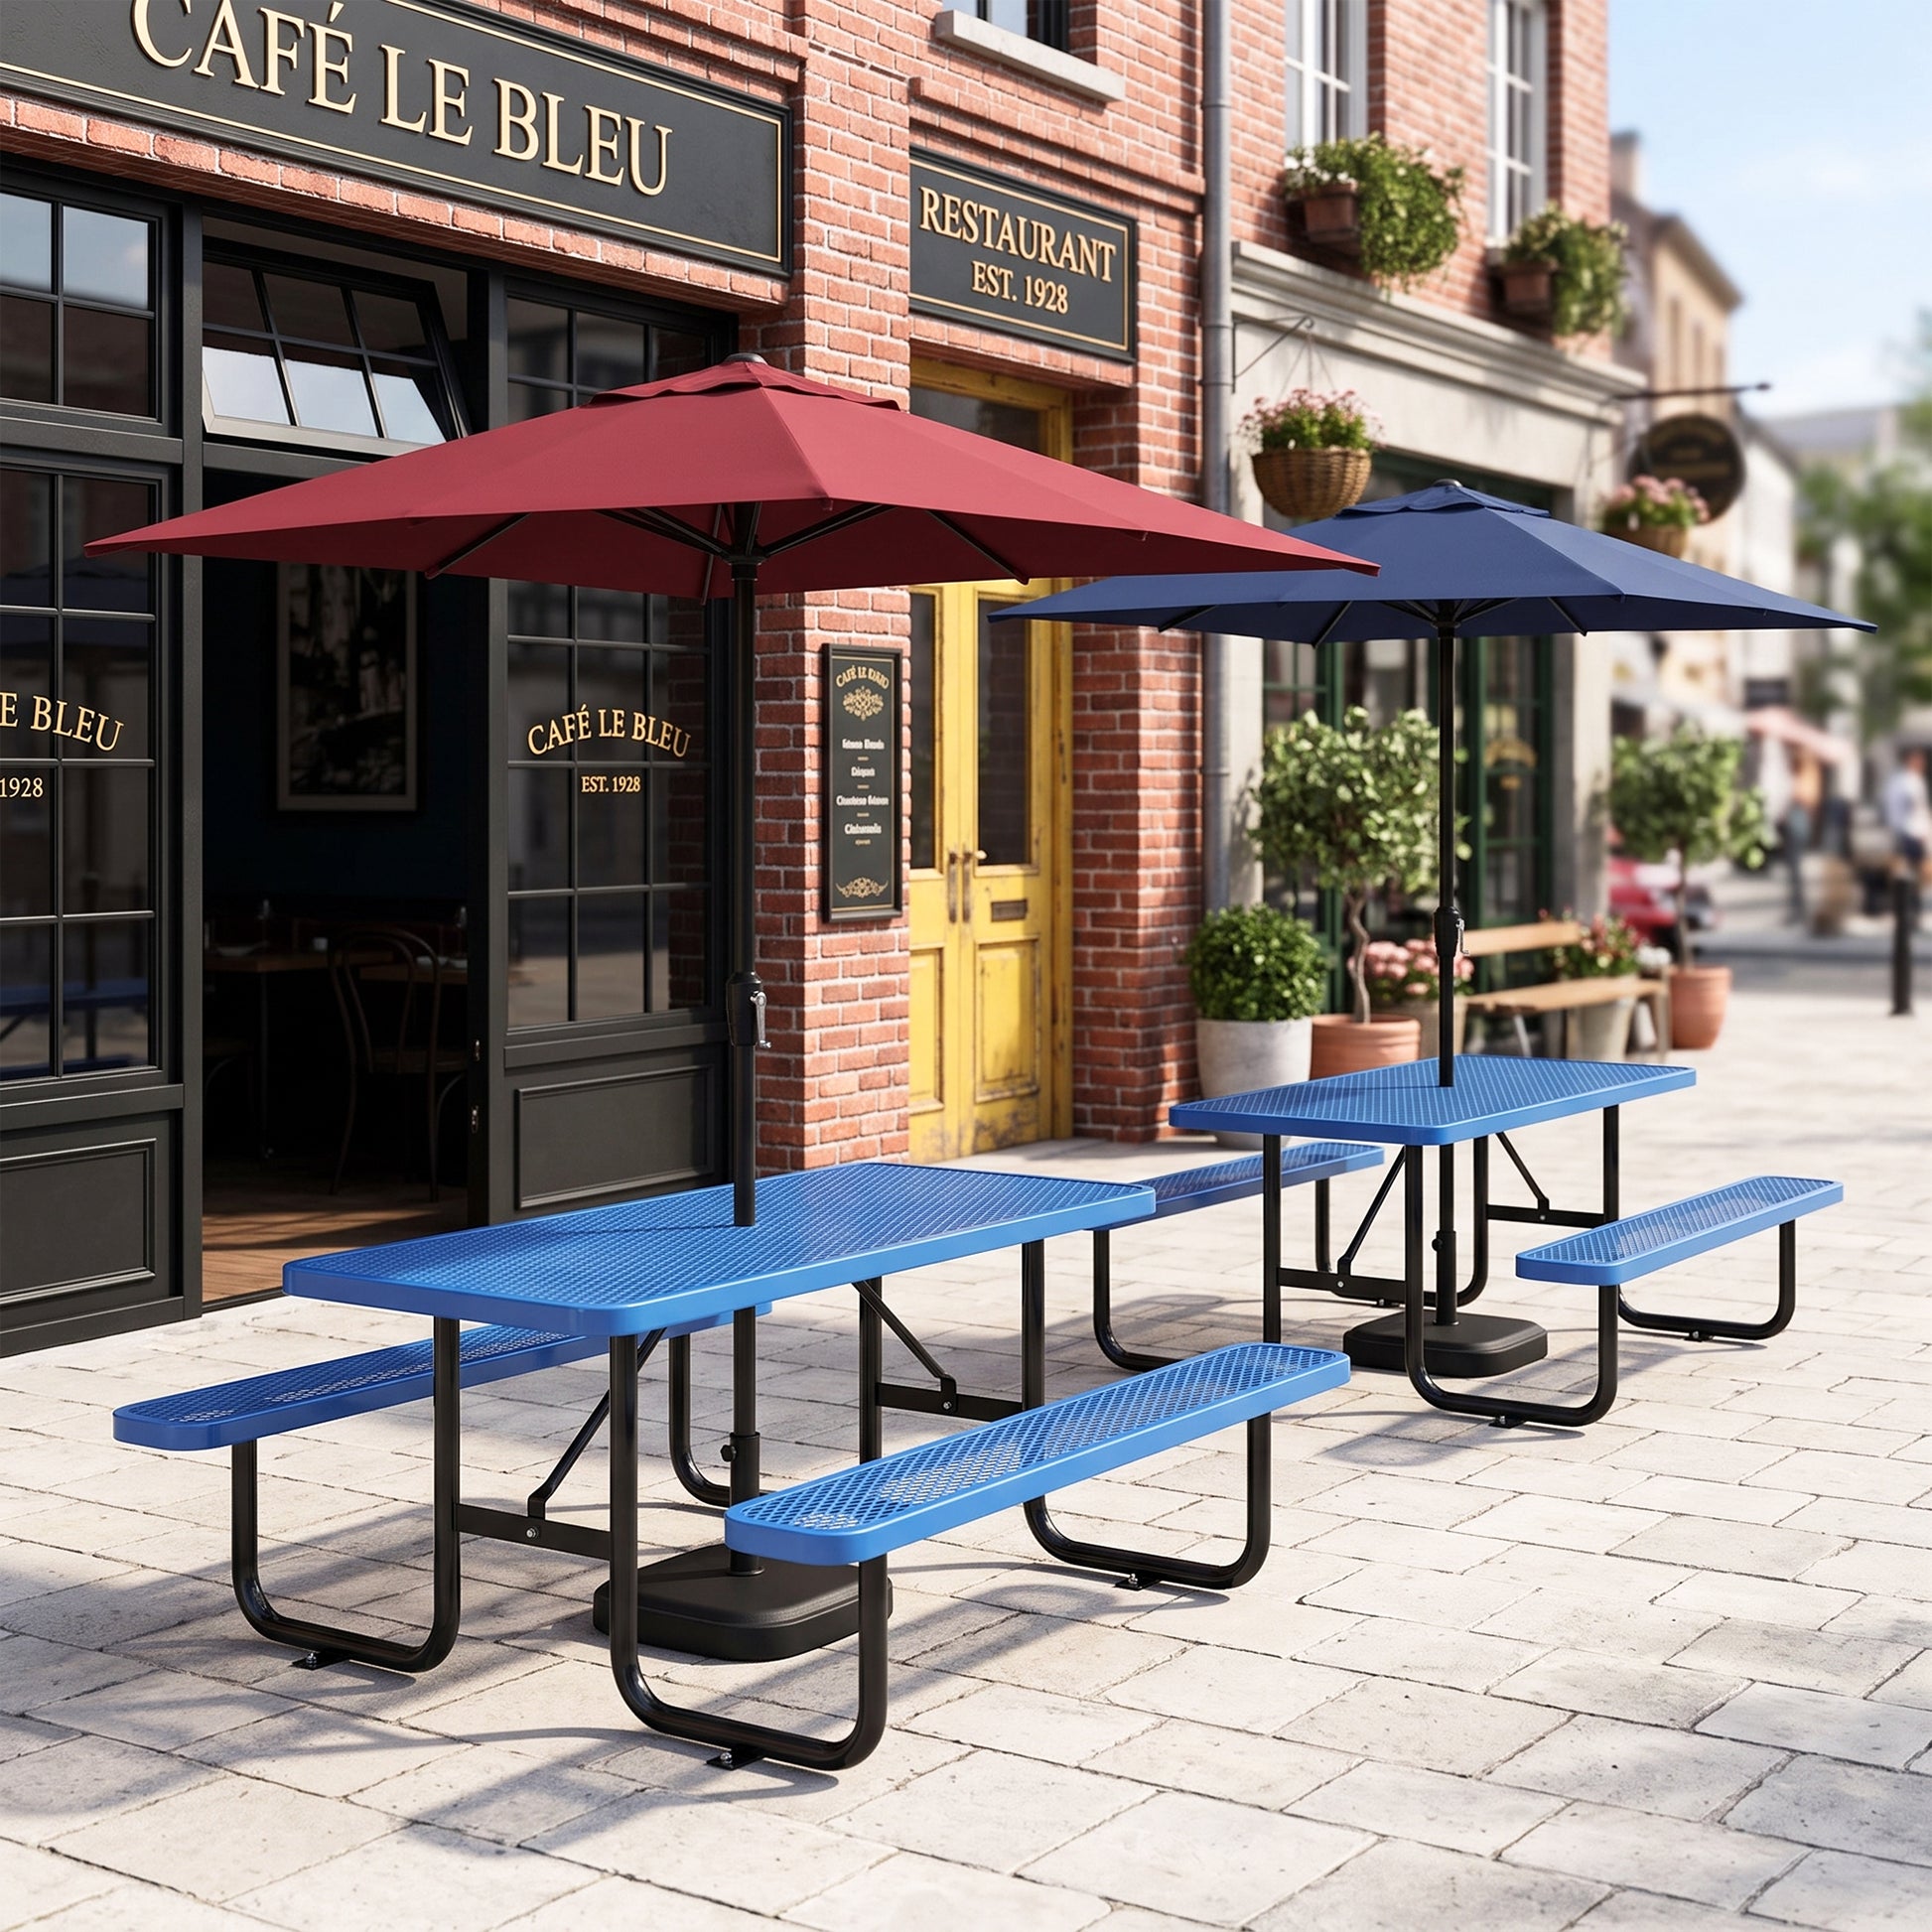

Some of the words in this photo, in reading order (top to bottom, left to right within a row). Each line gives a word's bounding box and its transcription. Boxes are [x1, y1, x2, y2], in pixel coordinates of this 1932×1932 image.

[131, 0, 356, 114] CAFÉ
[379, 44, 474, 146] LE
[493, 77, 673, 196] BLEU
[919, 186, 1117, 282] RESTAURANT
[971, 260, 1018, 302] EST.
[1024, 275, 1068, 315] 1928
[30, 695, 124, 752] BLEU
[527, 704, 592, 756] CAFÉ
[598, 709, 625, 738] LE
[631, 712, 691, 758] BLEU
[0, 777, 44, 798] 1928
[581, 776, 610, 792] EST.
[612, 776, 640, 792] 1928
